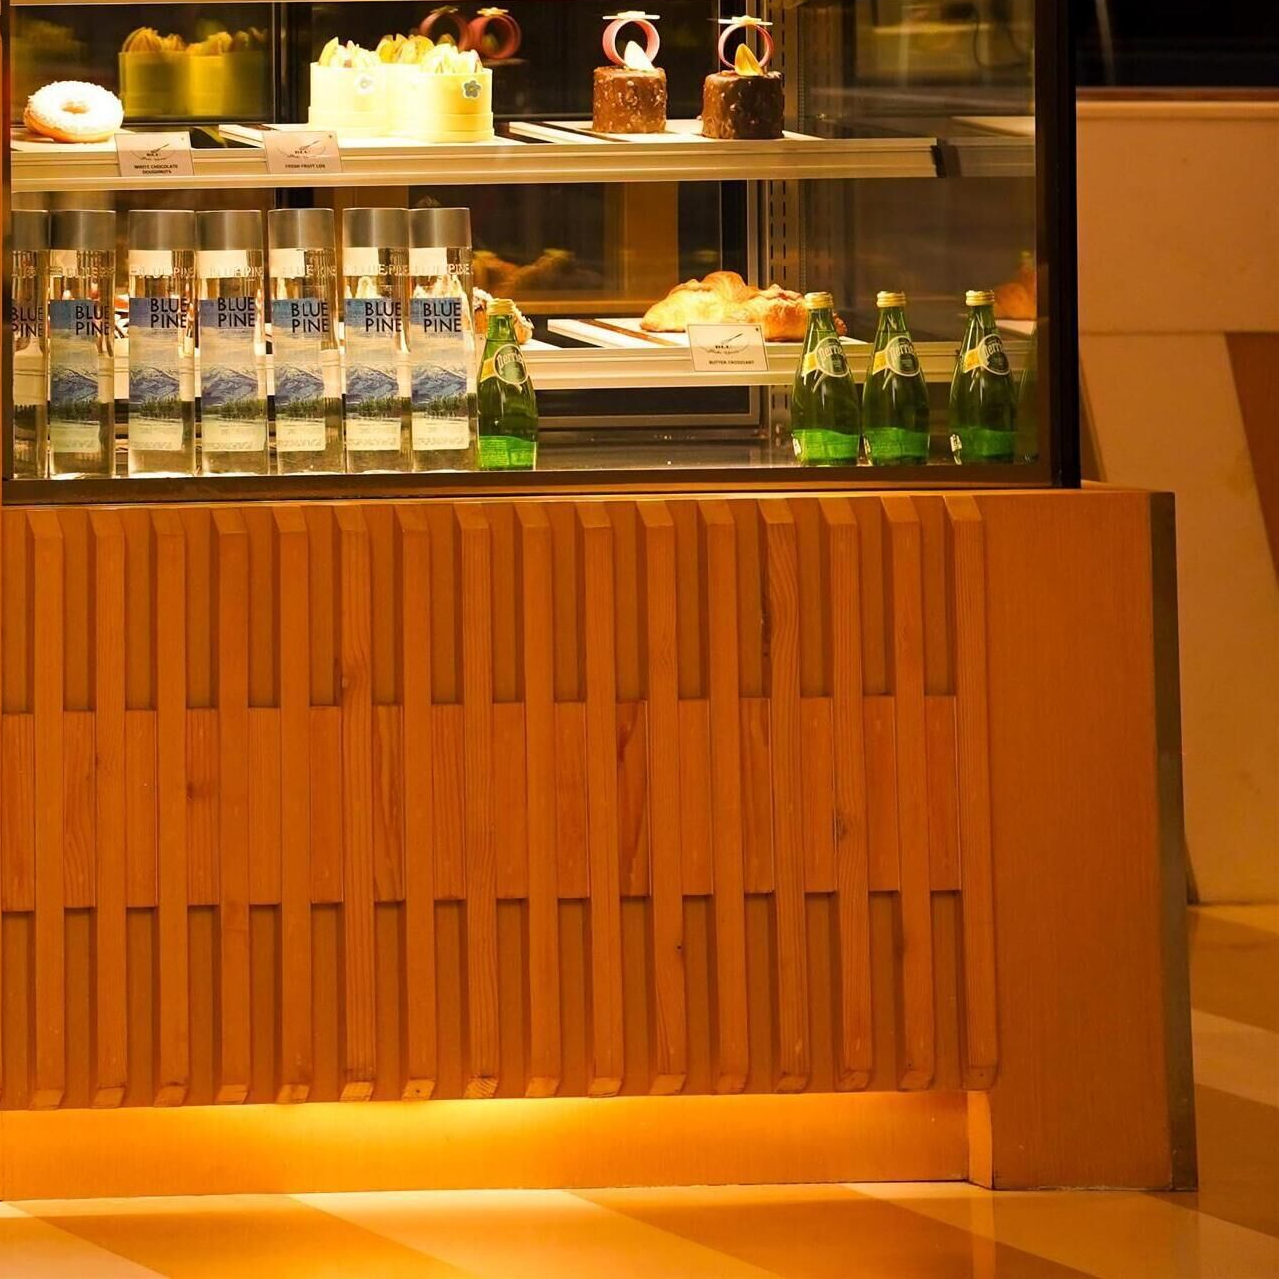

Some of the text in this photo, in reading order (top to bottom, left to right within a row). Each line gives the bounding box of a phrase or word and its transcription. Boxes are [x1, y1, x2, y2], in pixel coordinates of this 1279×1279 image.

[151, 298, 186, 312] BLUE
[218, 297, 255, 311] BLUE
[292, 303, 328, 317] BLUE
[365, 302, 401, 316] BLUE
[424, 302, 461, 316] BLUE
[151, 314, 186, 328] PINE
[218, 313, 255, 327] PINE
[292, 319, 329, 333] PINE
[365, 318, 401, 332] PINE
[424, 318, 461, 332] PINE
